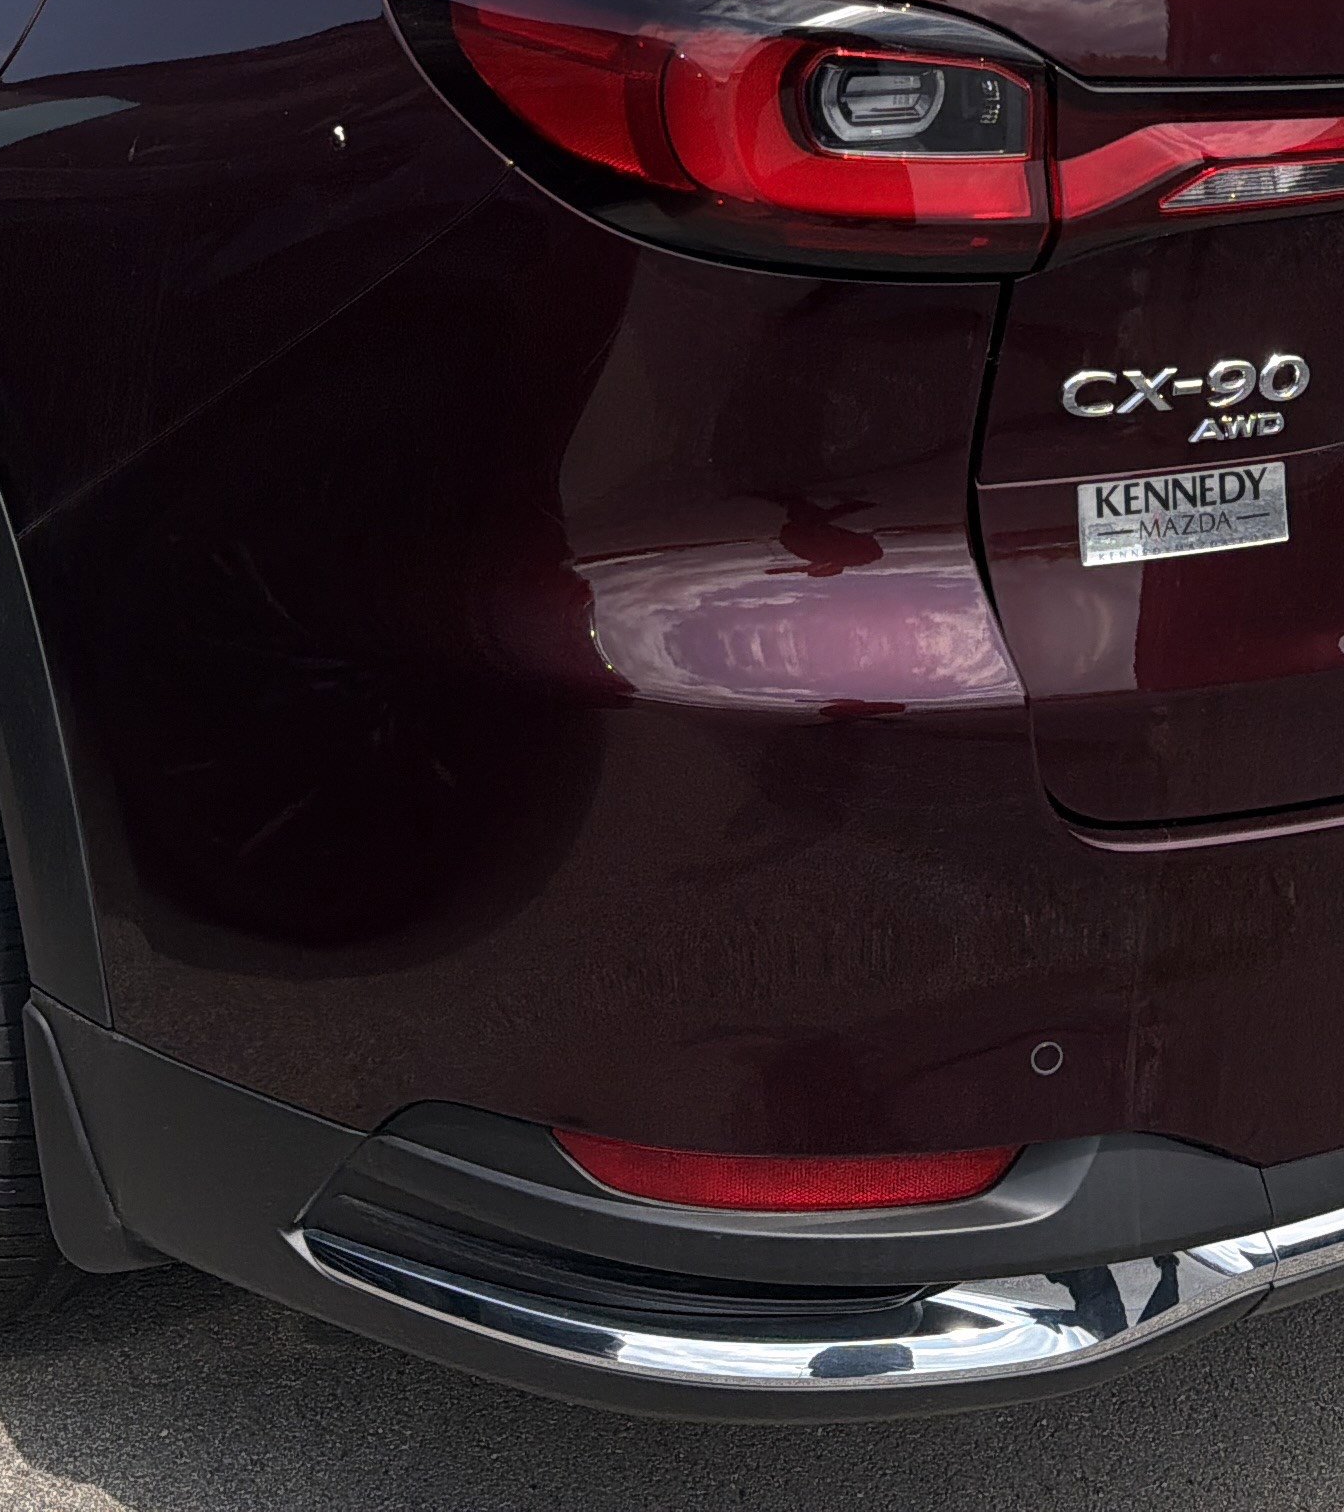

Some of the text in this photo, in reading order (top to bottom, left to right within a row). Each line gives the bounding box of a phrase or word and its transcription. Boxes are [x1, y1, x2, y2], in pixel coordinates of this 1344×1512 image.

[1062, 353, 1311, 418] CX-90
[1187, 411, 1285, 443] AWD
[1095, 467, 1268, 519] KENNEDY
[1139, 510, 1232, 540] MAZDA
